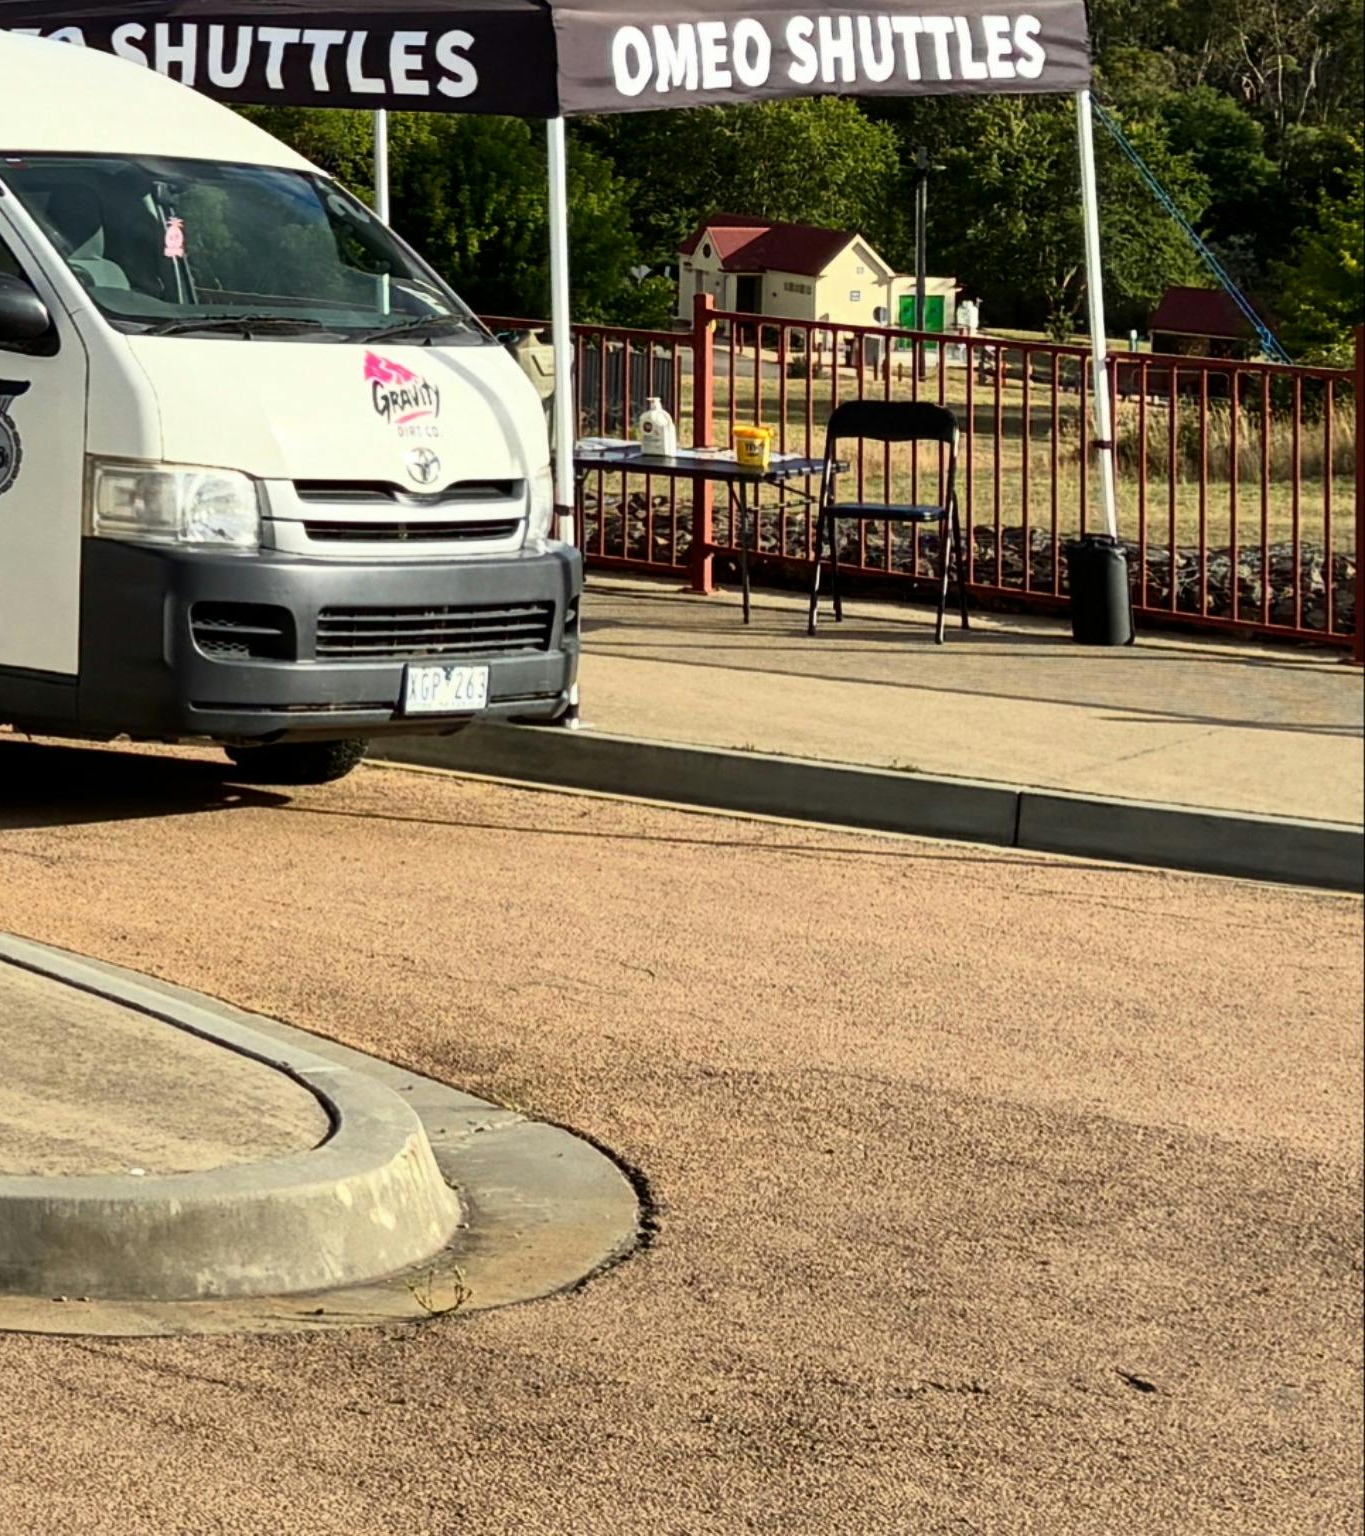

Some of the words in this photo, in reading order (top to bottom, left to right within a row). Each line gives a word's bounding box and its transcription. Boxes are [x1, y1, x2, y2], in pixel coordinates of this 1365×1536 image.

[111, 22, 479, 98] SHUTTLES
[612, 18, 771, 96] OMEO
[785, 14, 1047, 84] SHUTTLES
[409, 671, 441, 701] XGP
[455, 670, 486, 700] 263
